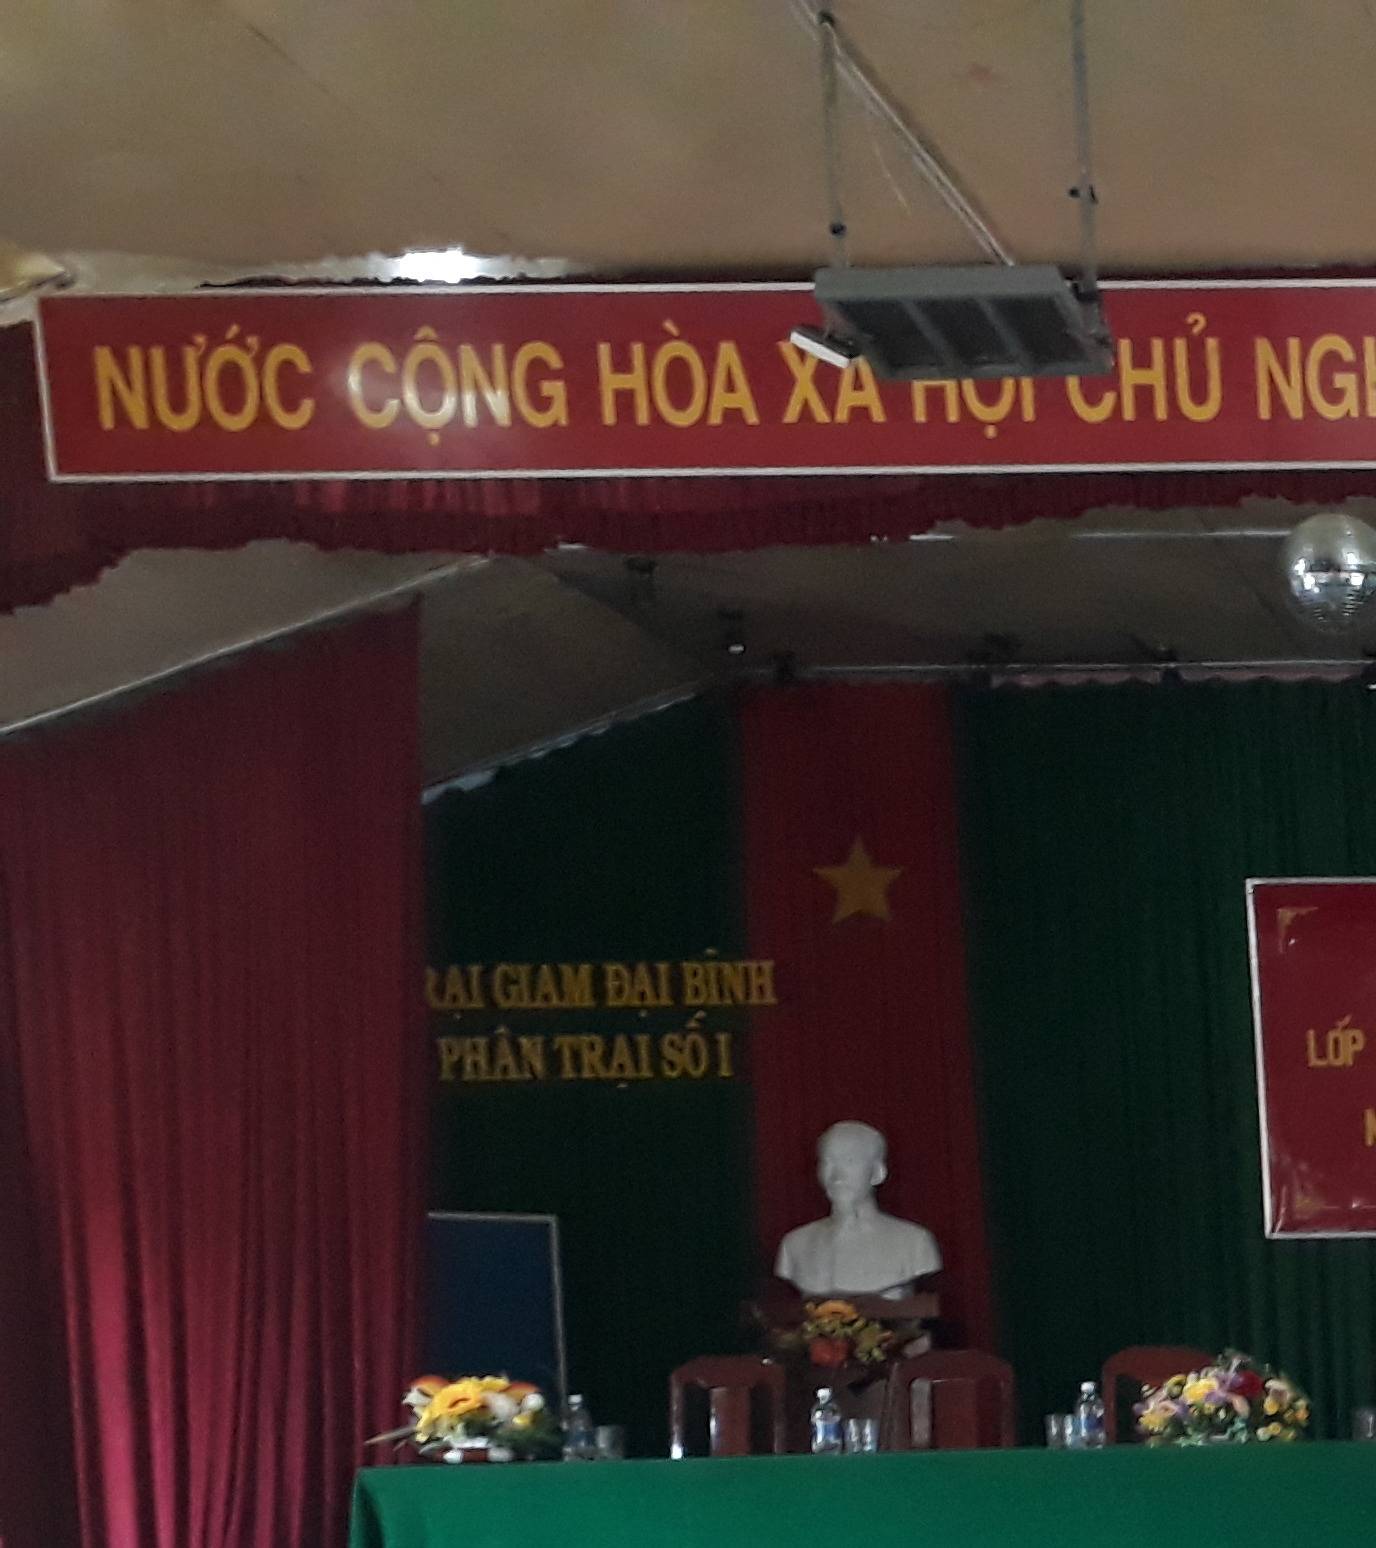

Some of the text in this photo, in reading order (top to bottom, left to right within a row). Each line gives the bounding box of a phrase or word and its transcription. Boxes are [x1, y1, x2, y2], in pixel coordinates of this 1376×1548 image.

[94, 324, 315, 431] NƯỚC
[348, 326, 568, 445] CỘNG
[600, 318, 760, 426] HÒA
[493, 963, 596, 1008] GIAM
[603, 962, 675, 1018] ĐẠI
[682, 948, 778, 1007] BÌNH
[437, 1026, 547, 1081] PHÂN
[554, 1034, 654, 1088] TRẠI
[661, 1010, 709, 1079] SỐ
[1307, 1014, 1365, 1067] LỚP
